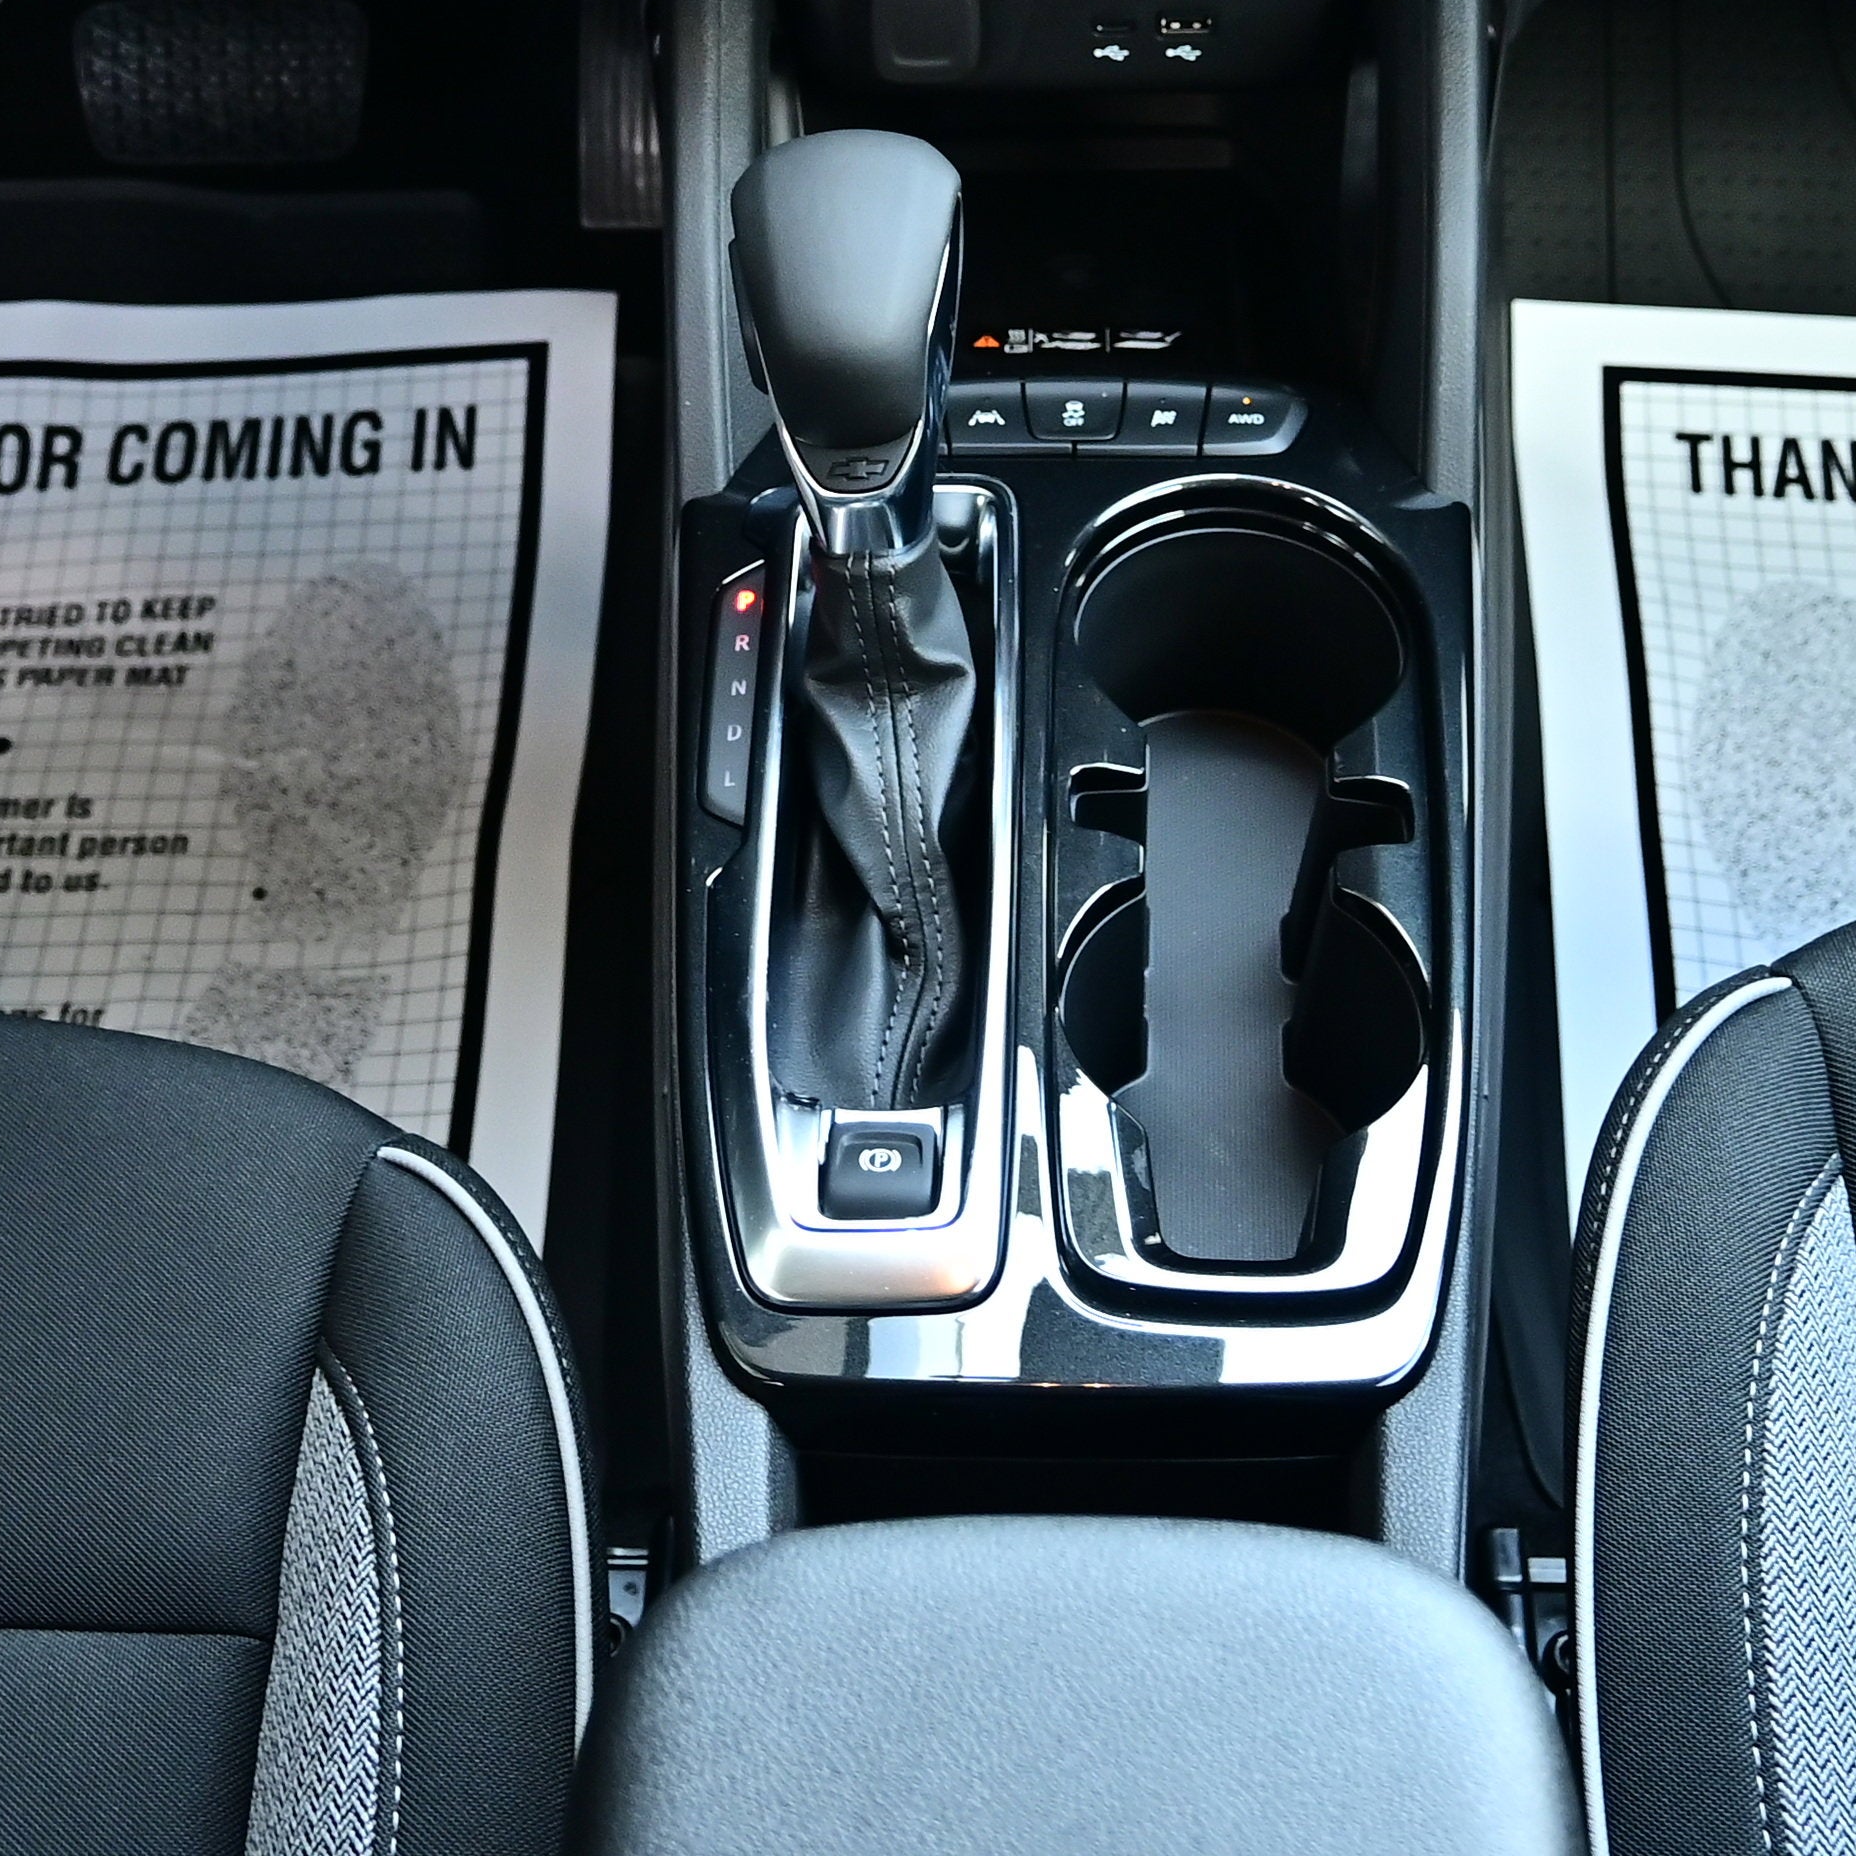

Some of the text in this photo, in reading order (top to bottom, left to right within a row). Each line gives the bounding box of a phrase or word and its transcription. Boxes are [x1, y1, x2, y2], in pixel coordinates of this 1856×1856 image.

[1228, 412, 1265, 426] AWD
[108, 407, 383, 488] COMING
[408, 403, 478, 472] IN
[95, 599, 131, 625] TO
[139, 595, 217, 622] KEEP
[735, 590, 756, 612] P
[114, 630, 215, 657] CLEAN
[734, 634, 750, 652] R
[16, 666, 116, 689] PAPER
[125, 664, 190, 687] MAT
[731, 680, 746, 696] N
[727, 724, 742, 741] D
[724, 770, 736, 787] L
[64, 793, 92, 819] is
[78, 831, 189, 859] person
[20, 867, 53, 893] to
